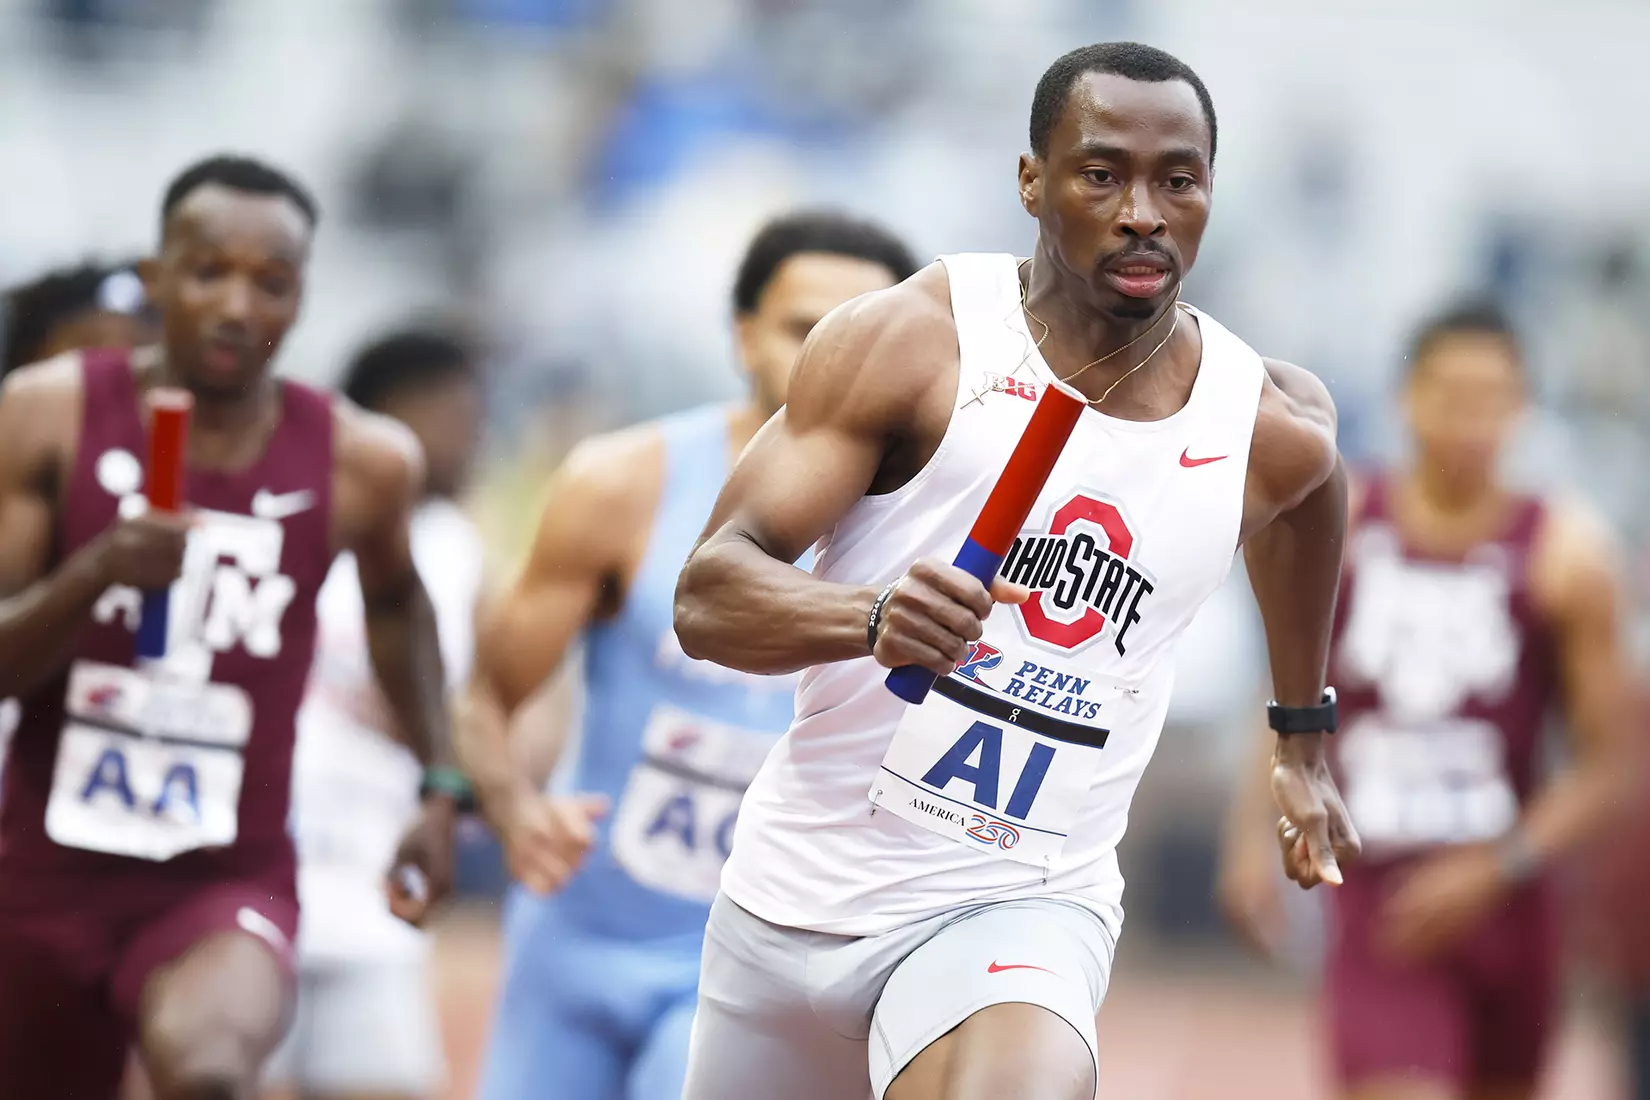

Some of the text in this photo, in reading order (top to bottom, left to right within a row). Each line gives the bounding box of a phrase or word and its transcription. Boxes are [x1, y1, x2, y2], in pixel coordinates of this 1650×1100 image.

[1052, 532, 1155, 658] STATE
[1002, 677, 1102, 721] RELAYS
[1014, 660, 1091, 697] PENN
[81, 748, 199, 819] AA
[920, 720, 1057, 821] AI
[908, 798, 1020, 851] AMERICA 250
